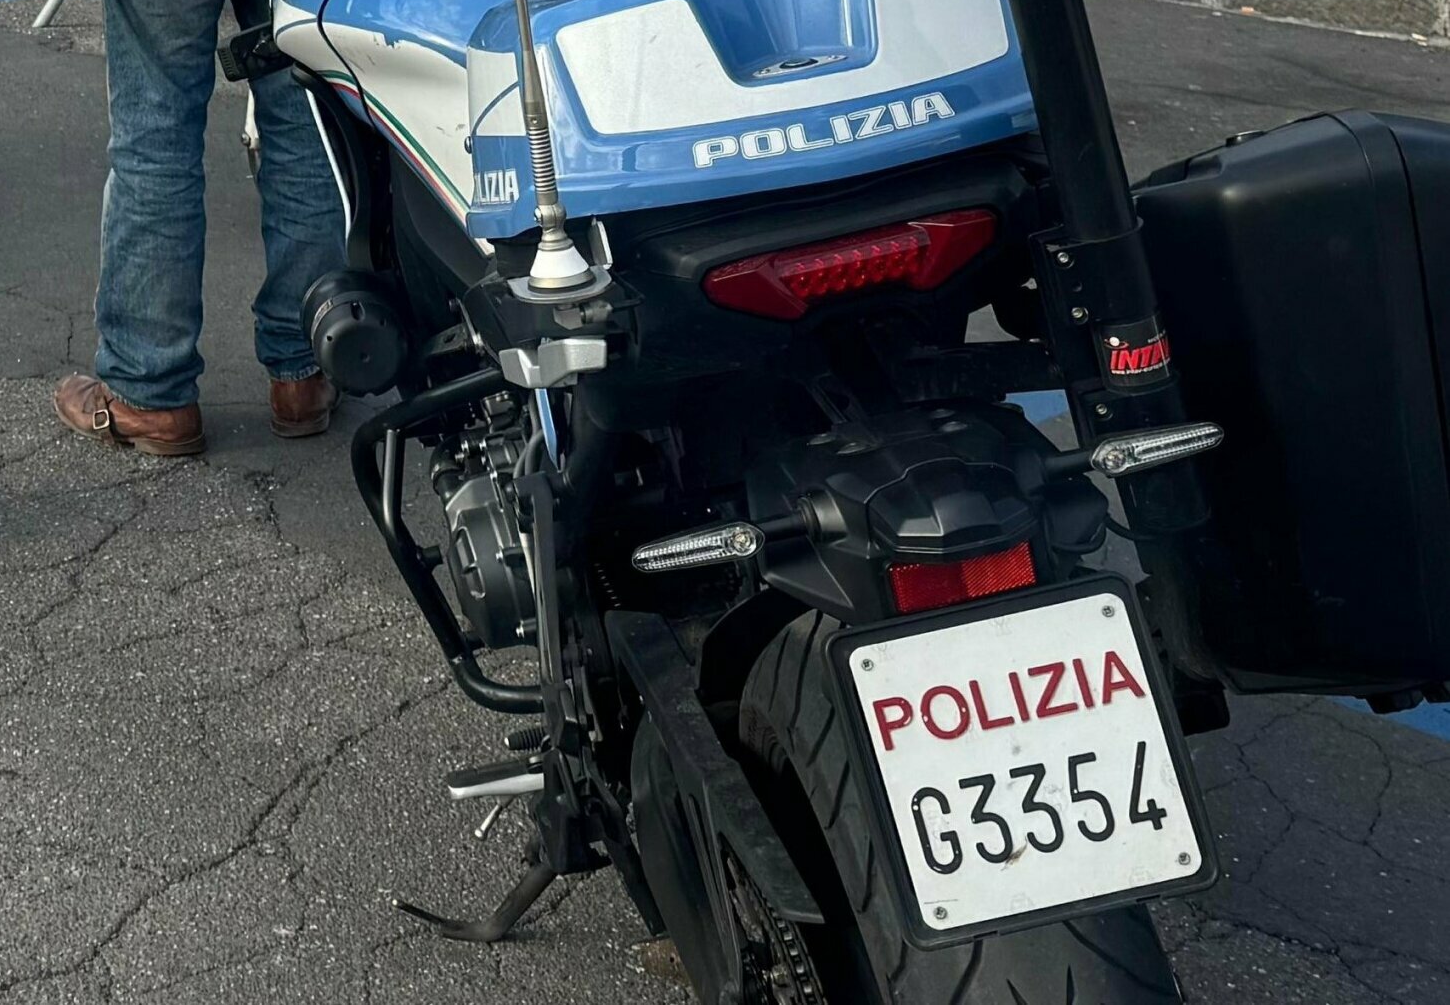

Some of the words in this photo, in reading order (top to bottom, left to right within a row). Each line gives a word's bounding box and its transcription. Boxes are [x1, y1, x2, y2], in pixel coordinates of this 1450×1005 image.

[692, 91, 956, 170] POLIZIA
[872, 650, 1147, 751] POLIZIA
[910, 740, 1168, 876] G3354
